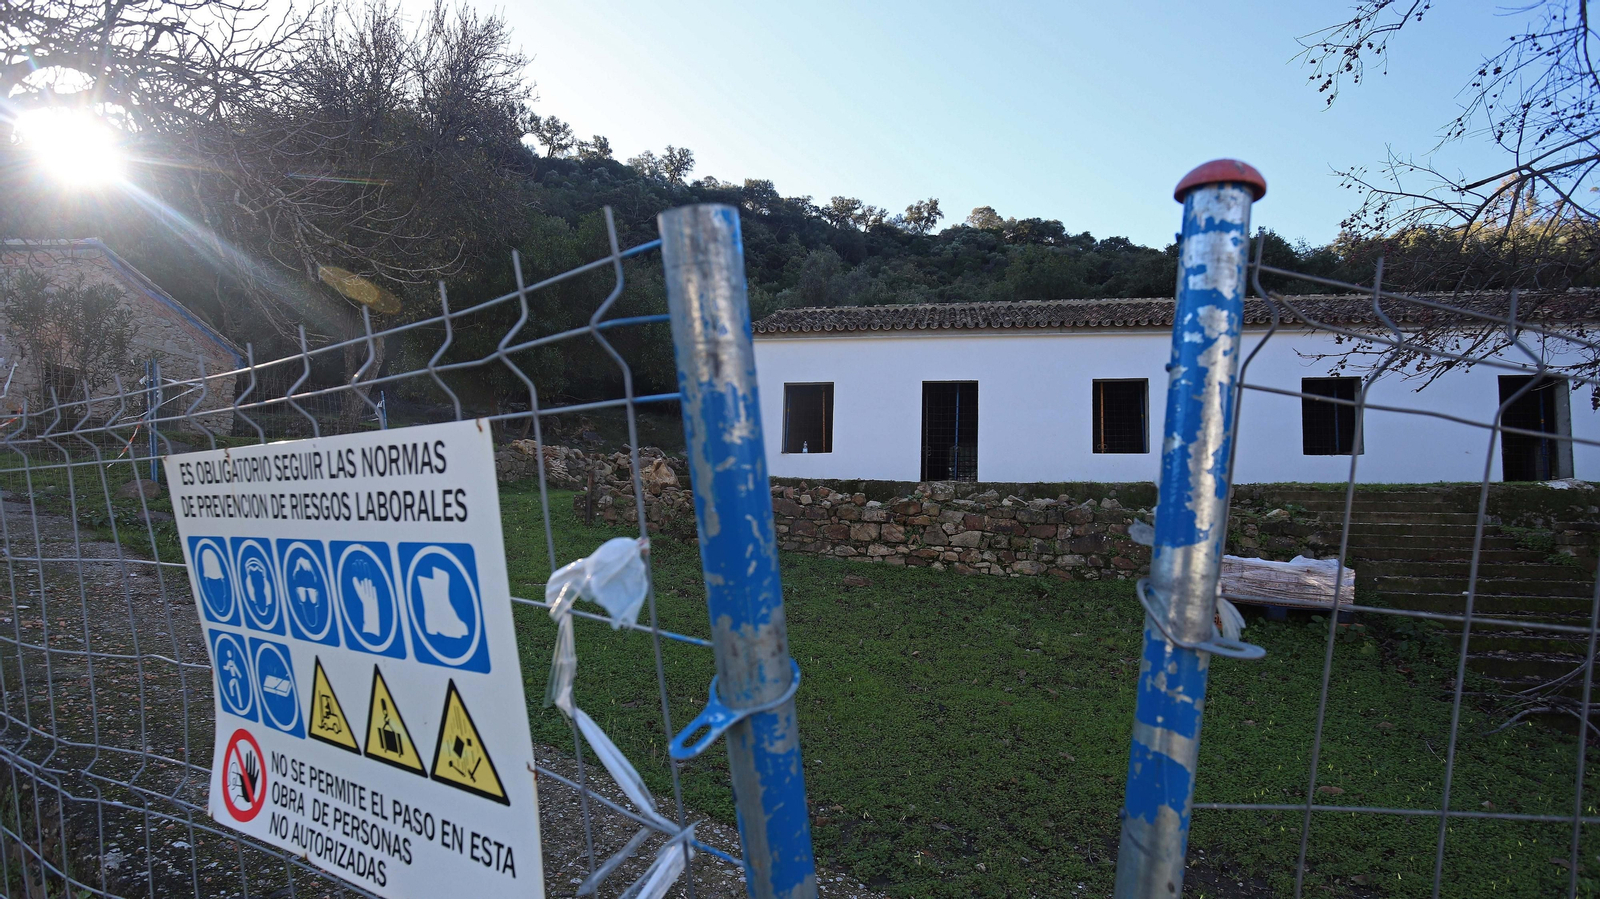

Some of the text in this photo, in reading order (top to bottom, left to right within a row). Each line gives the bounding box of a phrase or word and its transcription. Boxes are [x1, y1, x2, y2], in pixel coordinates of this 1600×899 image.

[179, 440, 447, 485] ES OBLIGATORIO SEGUIR LAS NORMAS
[181, 488, 468, 522] DE PREVENCION DE RIESGOS LABORALES
[269, 812, 387, 888] NO AUTORIZADAS
[271, 751, 517, 879] NO SE PERMITE EL PASO EN ESTA
[271, 781, 413, 866] OBRA DE PERSONAS
